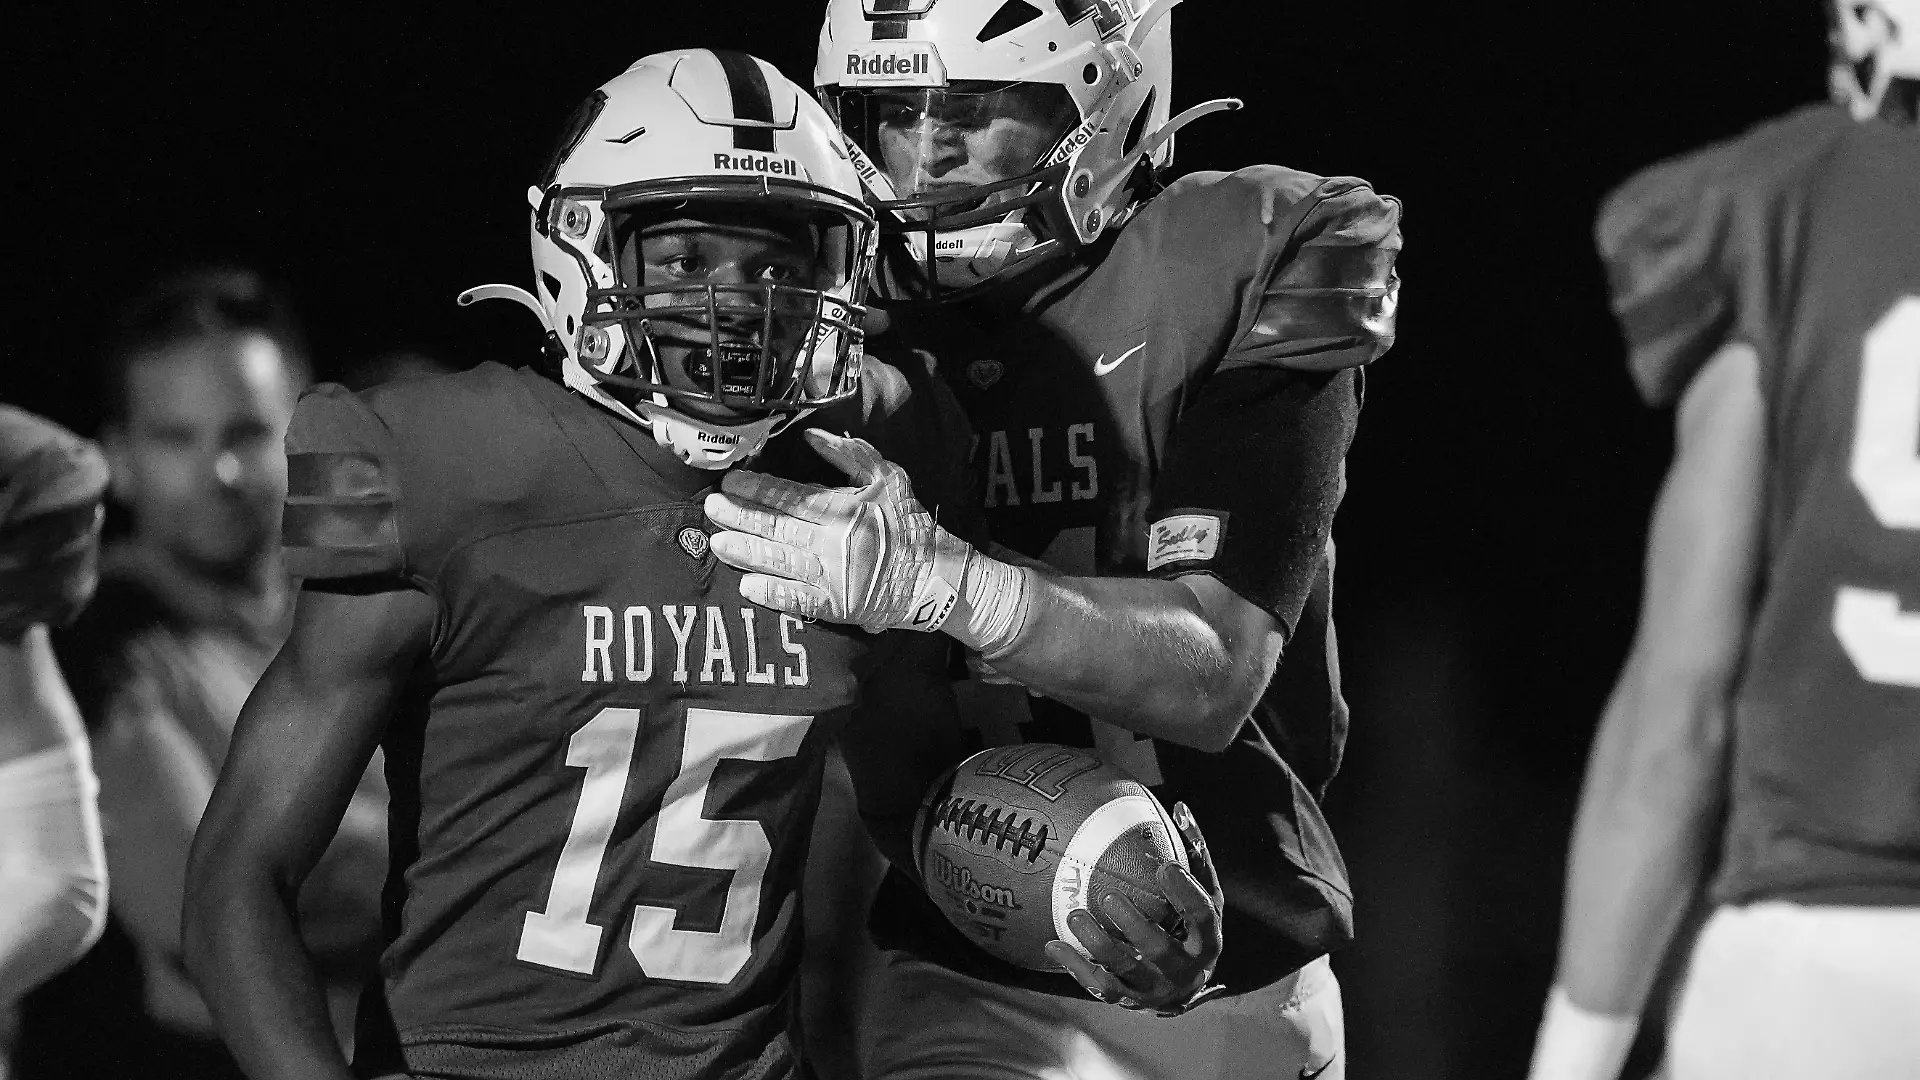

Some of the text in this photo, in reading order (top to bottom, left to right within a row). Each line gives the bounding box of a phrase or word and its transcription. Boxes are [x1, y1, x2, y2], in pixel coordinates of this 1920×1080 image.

[846, 53, 929, 75] Riddell
[713, 152, 797, 177] Riddell
[1046, 122, 1096, 167] ddell
[935, 239, 964, 250] ddell
[697, 430, 741, 446] Riddell
[969, 422, 1099, 508] ALS
[581, 604, 810, 686] ROYALS
[516, 707, 815, 984] 15
[932, 850, 1017, 911] Wilson
